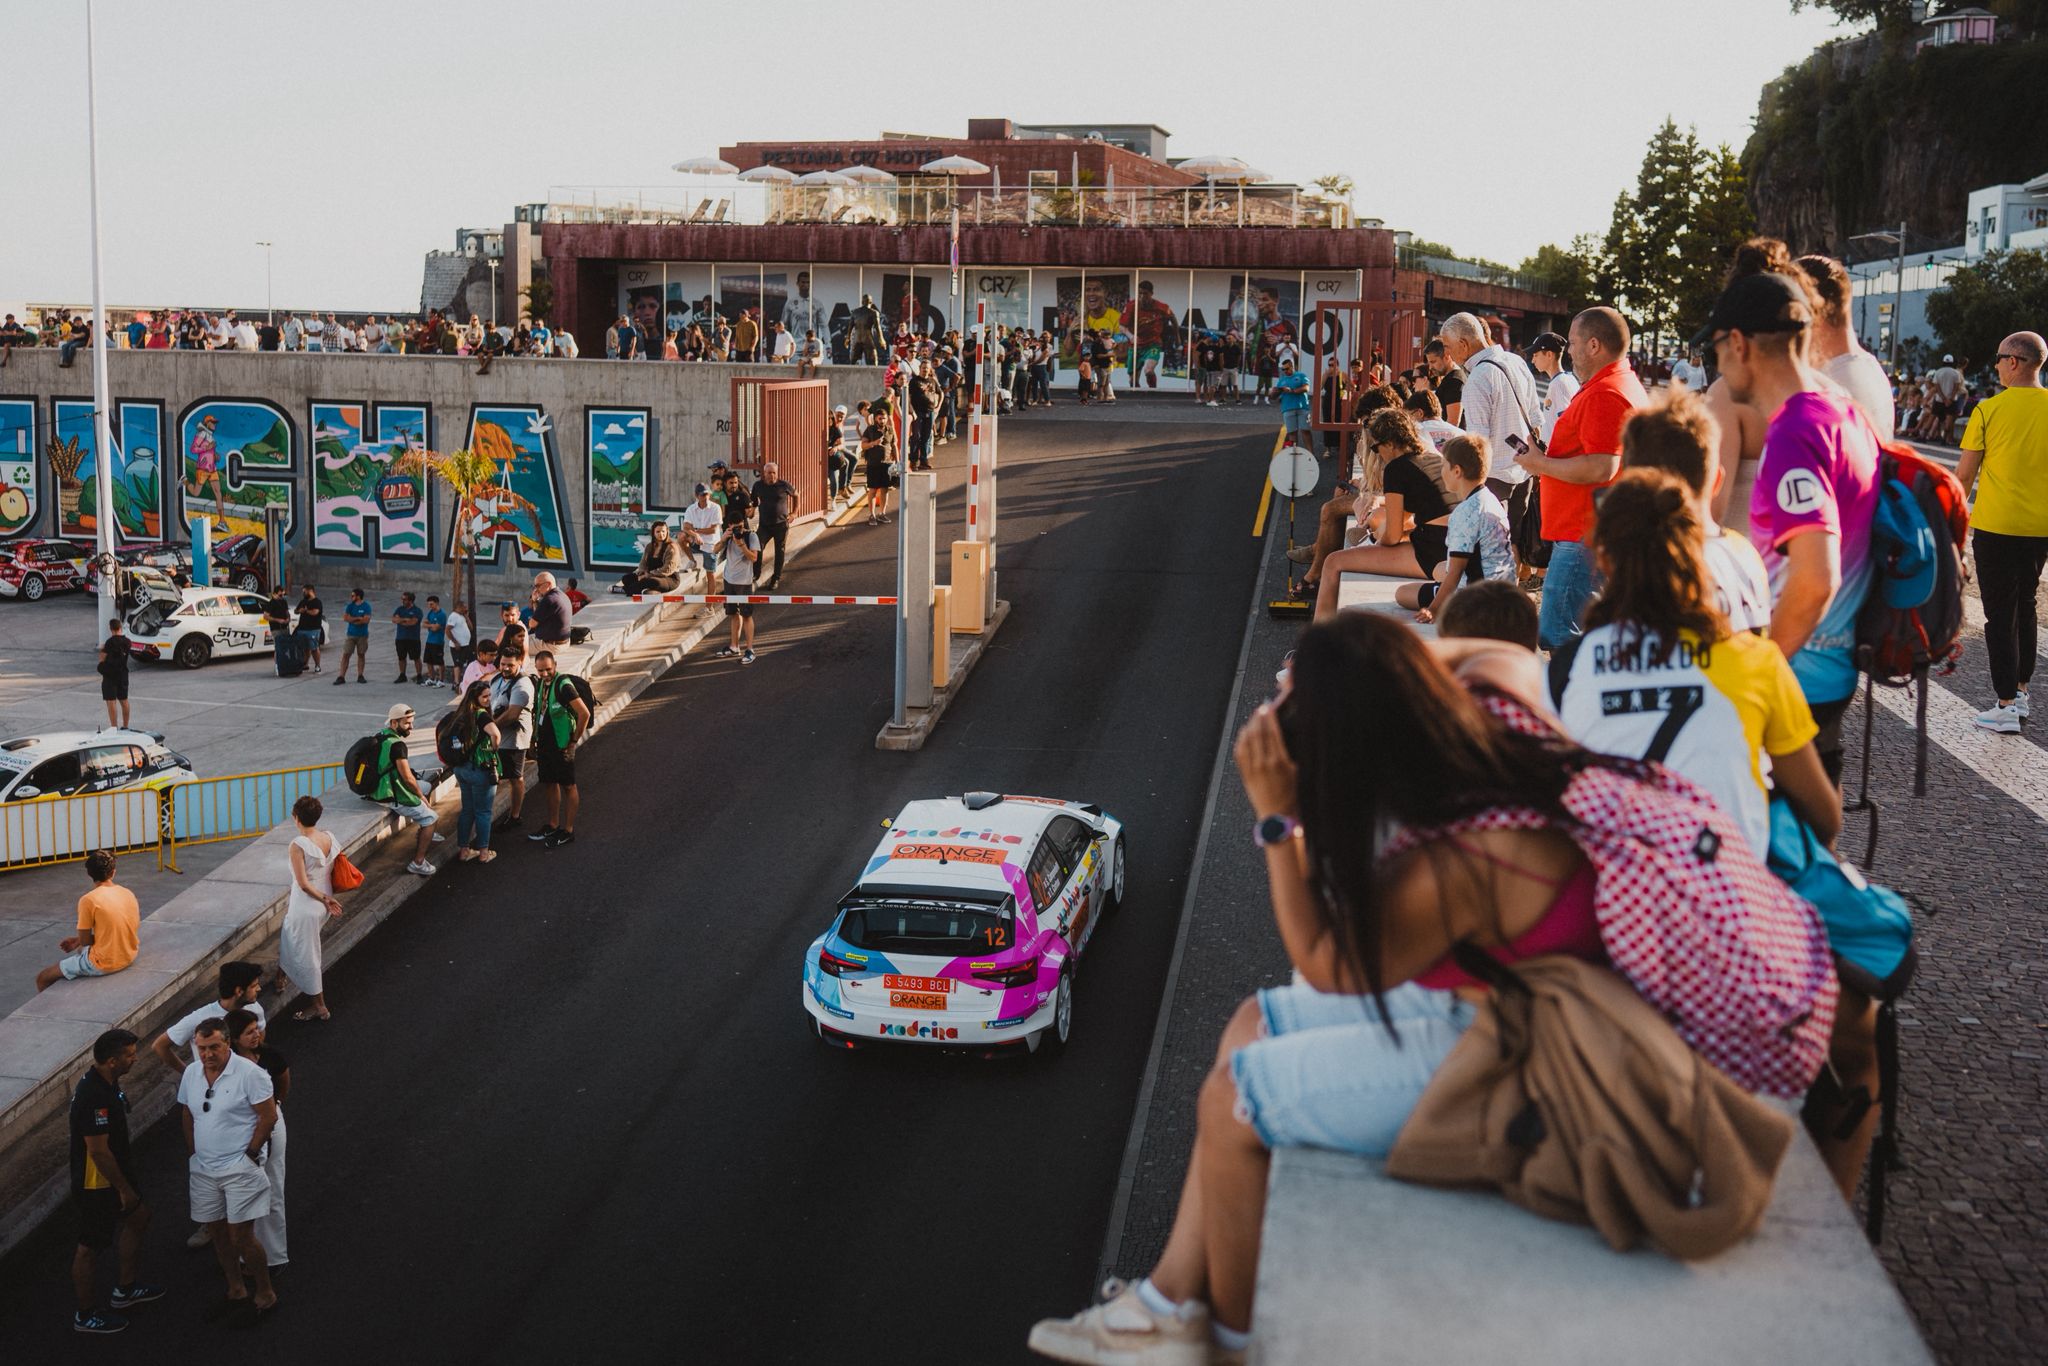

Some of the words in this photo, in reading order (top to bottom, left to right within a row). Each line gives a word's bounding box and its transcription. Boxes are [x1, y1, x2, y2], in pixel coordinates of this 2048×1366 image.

[762, 150, 844, 165] PESTANA
[850, 150, 879, 166] CR7
[627, 270, 649, 285] CR7
[979, 276, 1016, 298] CR7
[1316, 280, 1342, 295] CR7
[1601, 685, 1705, 765] 7
[984, 927, 1007, 946] 12
[885, 976, 892, 986] S
[897, 977, 923, 989] 5493
[930, 980, 949, 991] BCL
